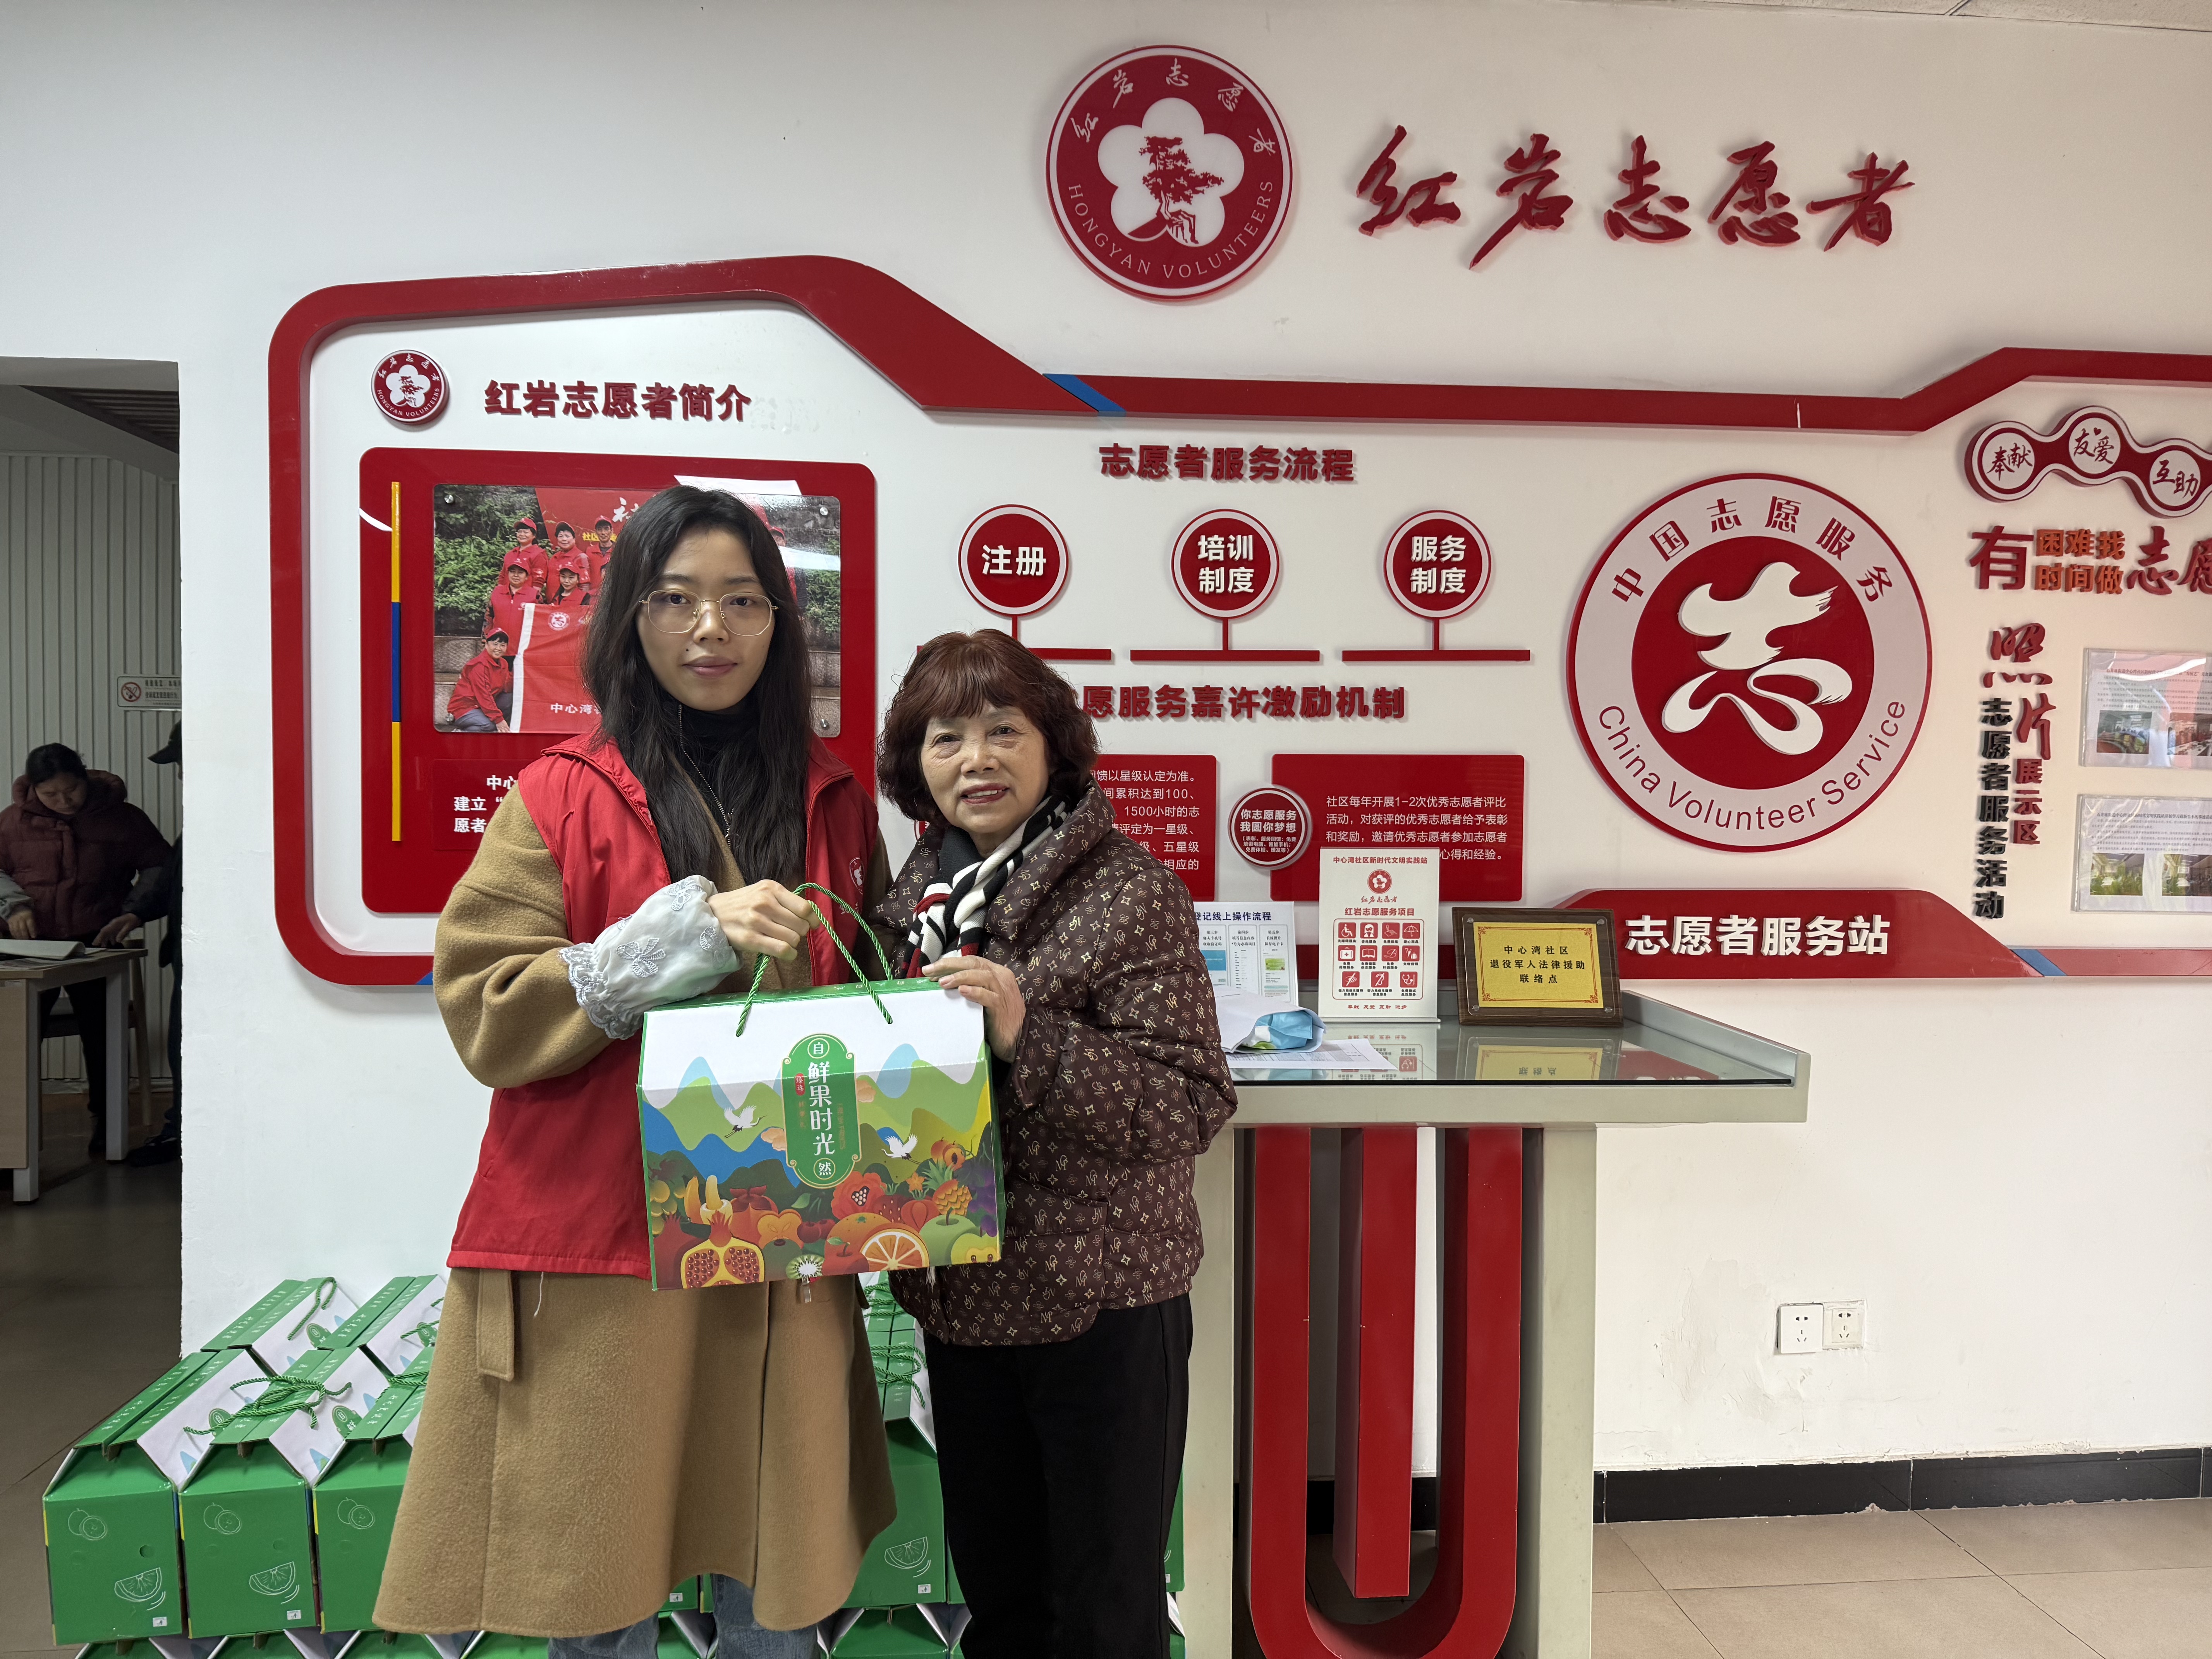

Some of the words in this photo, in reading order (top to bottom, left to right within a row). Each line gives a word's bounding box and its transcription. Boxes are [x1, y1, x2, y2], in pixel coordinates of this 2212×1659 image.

[1356, 124, 1915, 270] 红岩志愿者
[1068, 184, 1151, 275] HONGYAN
[1163, 180, 1273, 279] VOLUNTEERS
[377, 389, 403, 416] HONGYAN
[406, 388, 440, 417] VOLUNTEERS
[484, 379, 752, 422] 红岩志愿者简介
[2073, 428, 2114, 464] 友爱
[1098, 442, 1356, 483] 志愿者服务流程
[1987, 443, 2033, 481] 奉献
[2152, 459, 2199, 498] 互助
[1198, 534, 1254, 562] 培训
[1411, 534, 1467, 563] 服务
[1611, 496, 1893, 603] 中国志愿服务
[2036, 529, 2126, 560] 困难找
[981, 544, 1047, 577] 注册
[1198, 565, 1255, 594] 制度
[1410, 565, 1467, 596] 制度
[2034, 563, 2124, 594] 时间做
[1084, 684, 1405, 719] 愿服务嘉许激励机制
[1599, 705, 1661, 793] China
[1668, 781, 1815, 830] Volunteer
[1821, 700, 1905, 806] Service
[1103, 788, 1194, 799] 间累积达到100、
[1326, 796, 1506, 808] 社区每年开展1-2次优秀志愿者评比
[1973, 697, 2013, 919] 志愿者服务活动
[2012, 758, 2043, 844] 展示区
[454, 818, 487, 833] 愿者
[1124, 805, 1200, 817] 1500小时的志
[1240, 809, 1297, 821] 你志愿服务
[1326, 814, 1508, 825] 活动，对获评的优秀志愿者给予表彰
[1240, 821, 1296, 833] 我圆你梦想
[1326, 831, 1508, 843] 和奖励，邀请优秀志愿者参加志愿者
[1159, 859, 1199, 870] 相应的
[1440, 849, 1502, 860] 心得和经验。
[1345, 908, 1415, 917] 红岩志愿服务项目
[1504, 945, 1569, 955] 中心湾社区
[1625, 914, 1891, 957] 志愿者服务站
[1489, 959, 1585, 970] 退役军人法律援助
[1519, 974, 1558, 984] 联络点
[813, 1041, 824, 1055] 自
[808, 1061, 835, 1156] 鲜果时光
[818, 1162, 832, 1176] 然
